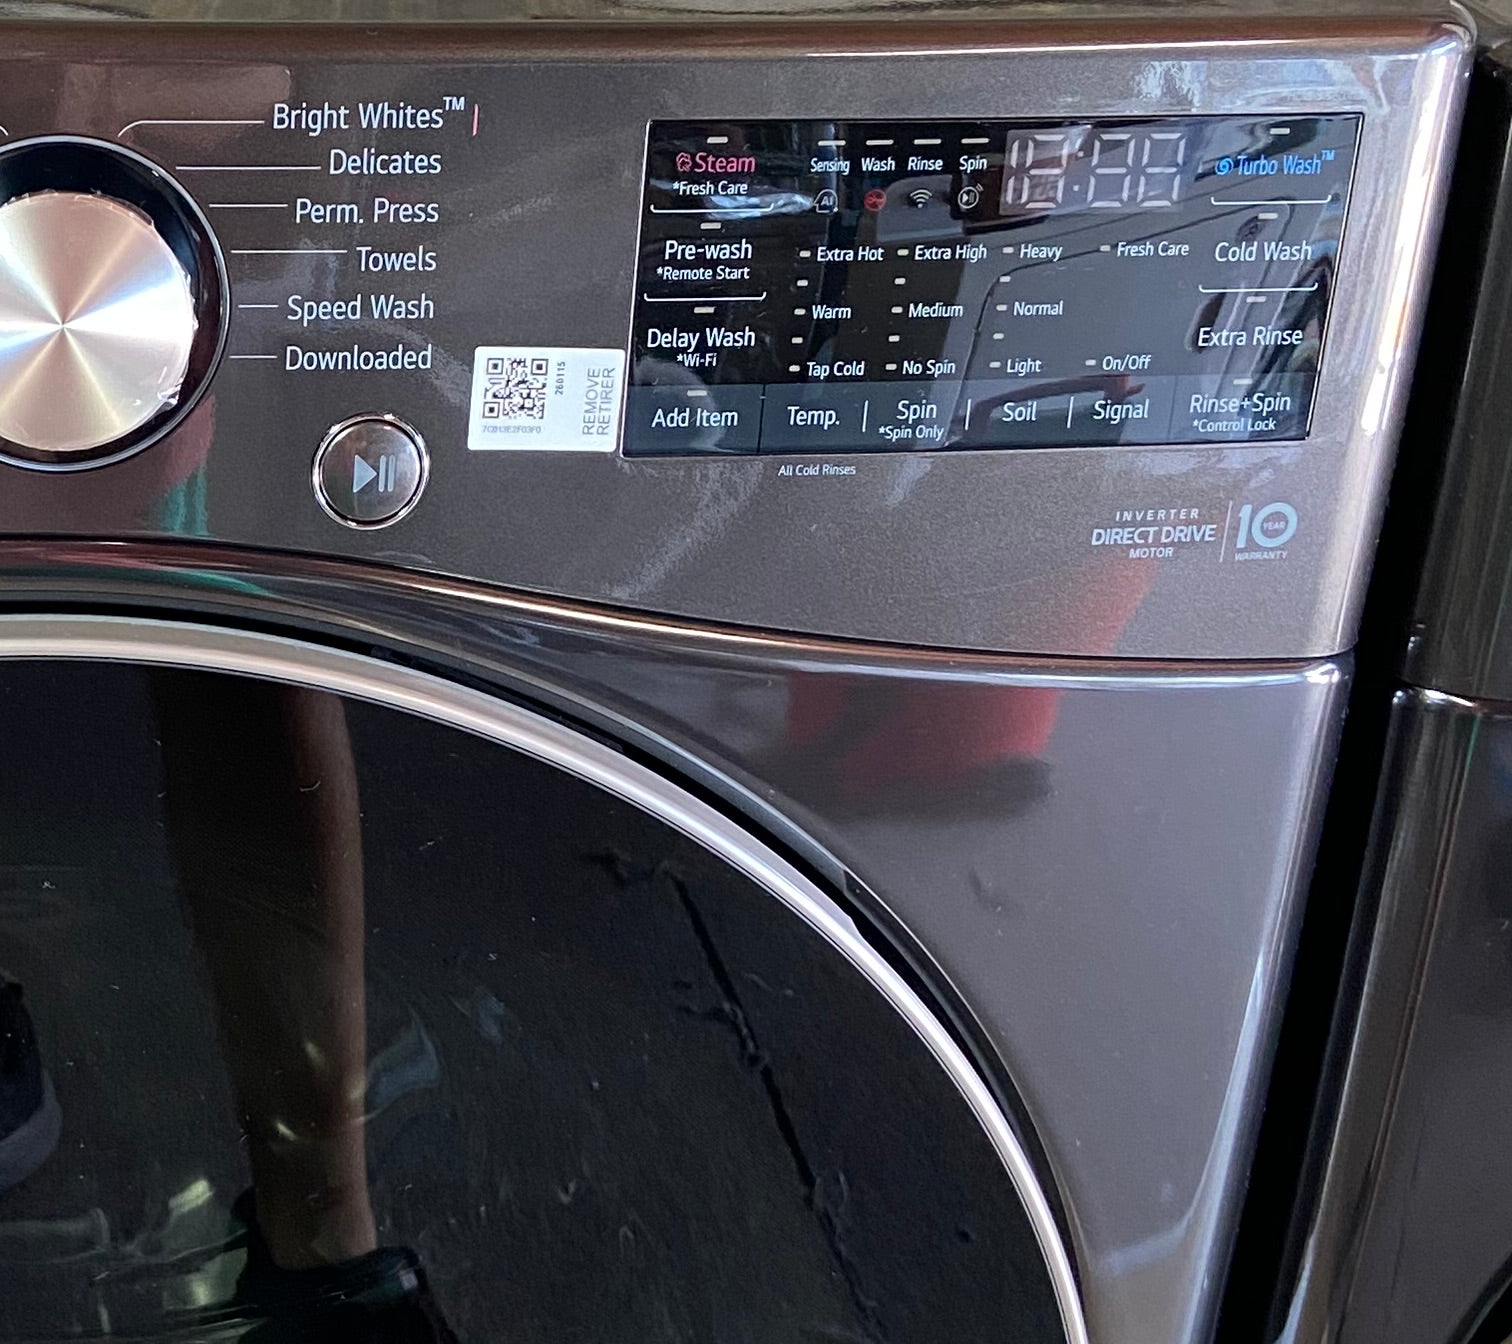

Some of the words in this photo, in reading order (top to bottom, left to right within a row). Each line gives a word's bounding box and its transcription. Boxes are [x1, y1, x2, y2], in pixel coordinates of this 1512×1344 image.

[272, 102, 350, 137] Bright
[329, 147, 442, 175] Delicates
[695, 153, 755, 173] Steam
[810, 157, 850, 175] Sensing
[861, 157, 895, 172] Wash
[907, 156, 943, 171] Rinse
[959, 155, 988, 172] Spin
[1237, 155, 1278, 175] Turbo
[718, 181, 748, 195] Care
[295, 197, 365, 224] Perm.
[373, 197, 439, 224] Press
[356, 245, 437, 272] Towels
[665, 239, 752, 259] Pre-wash
[816, 247, 853, 261] Extra
[857, 246, 885, 261] Hot
[914, 245, 952, 260] Extra
[955, 244, 988, 263] High
[1020, 244, 1063, 262] Heavy
[1117, 242, 1155, 257] Fresh
[1157, 241, 1189, 256] Care
[1214, 241, 1258, 262] Cold
[1263, 240, 1313, 261] Wash
[716, 266, 750, 280] Start
[287, 293, 362, 328] Speed
[370, 293, 434, 320] Wash
[812, 304, 852, 319] Warm
[908, 302, 963, 318] Medium
[1013, 300, 1064, 316] Normal
[647, 328, 700, 352] Delay
[705, 326, 756, 347] Wash
[1198, 327, 1247, 347] Extra
[1252, 325, 1303, 346] Rinse
[285, 343, 432, 371] Downloaded
[1102, 354, 1152, 372] On/Off
[806, 362, 831, 379] Tap
[833, 361, 865, 376] Cold
[902, 360, 923, 375] No
[926, 359, 956, 377] Spin
[1006, 358, 1042, 377] Light
[582, 367, 601, 435] REMOVE
[596, 367, 615, 436] RETIRER
[1093, 398, 1150, 424] Signal
[1189, 392, 1291, 417] Rinse+Spin
[651, 408, 688, 427] Add
[695, 407, 738, 427] Item
[787, 406, 840, 430] Temp.
[896, 399, 937, 424] Spin
[1002, 401, 1037, 422] Soil
[915, 424, 945, 442] Only
[1248, 418, 1277, 431] Lock
[778, 465, 793, 476] All
[795, 464, 820, 476] Cold
[822, 464, 856, 476] Rinses
[1116, 508, 1200, 522] INVERTER
[1091, 526, 1159, 546] DIRECT
[1160, 524, 1217, 544] DRIVE
[1236, 502, 1298, 549] 10
[1262, 520, 1287, 531] YEAR
[1129, 547, 1175, 559] MOTOR
[1234, 549, 1287, 561] WARRANTY
